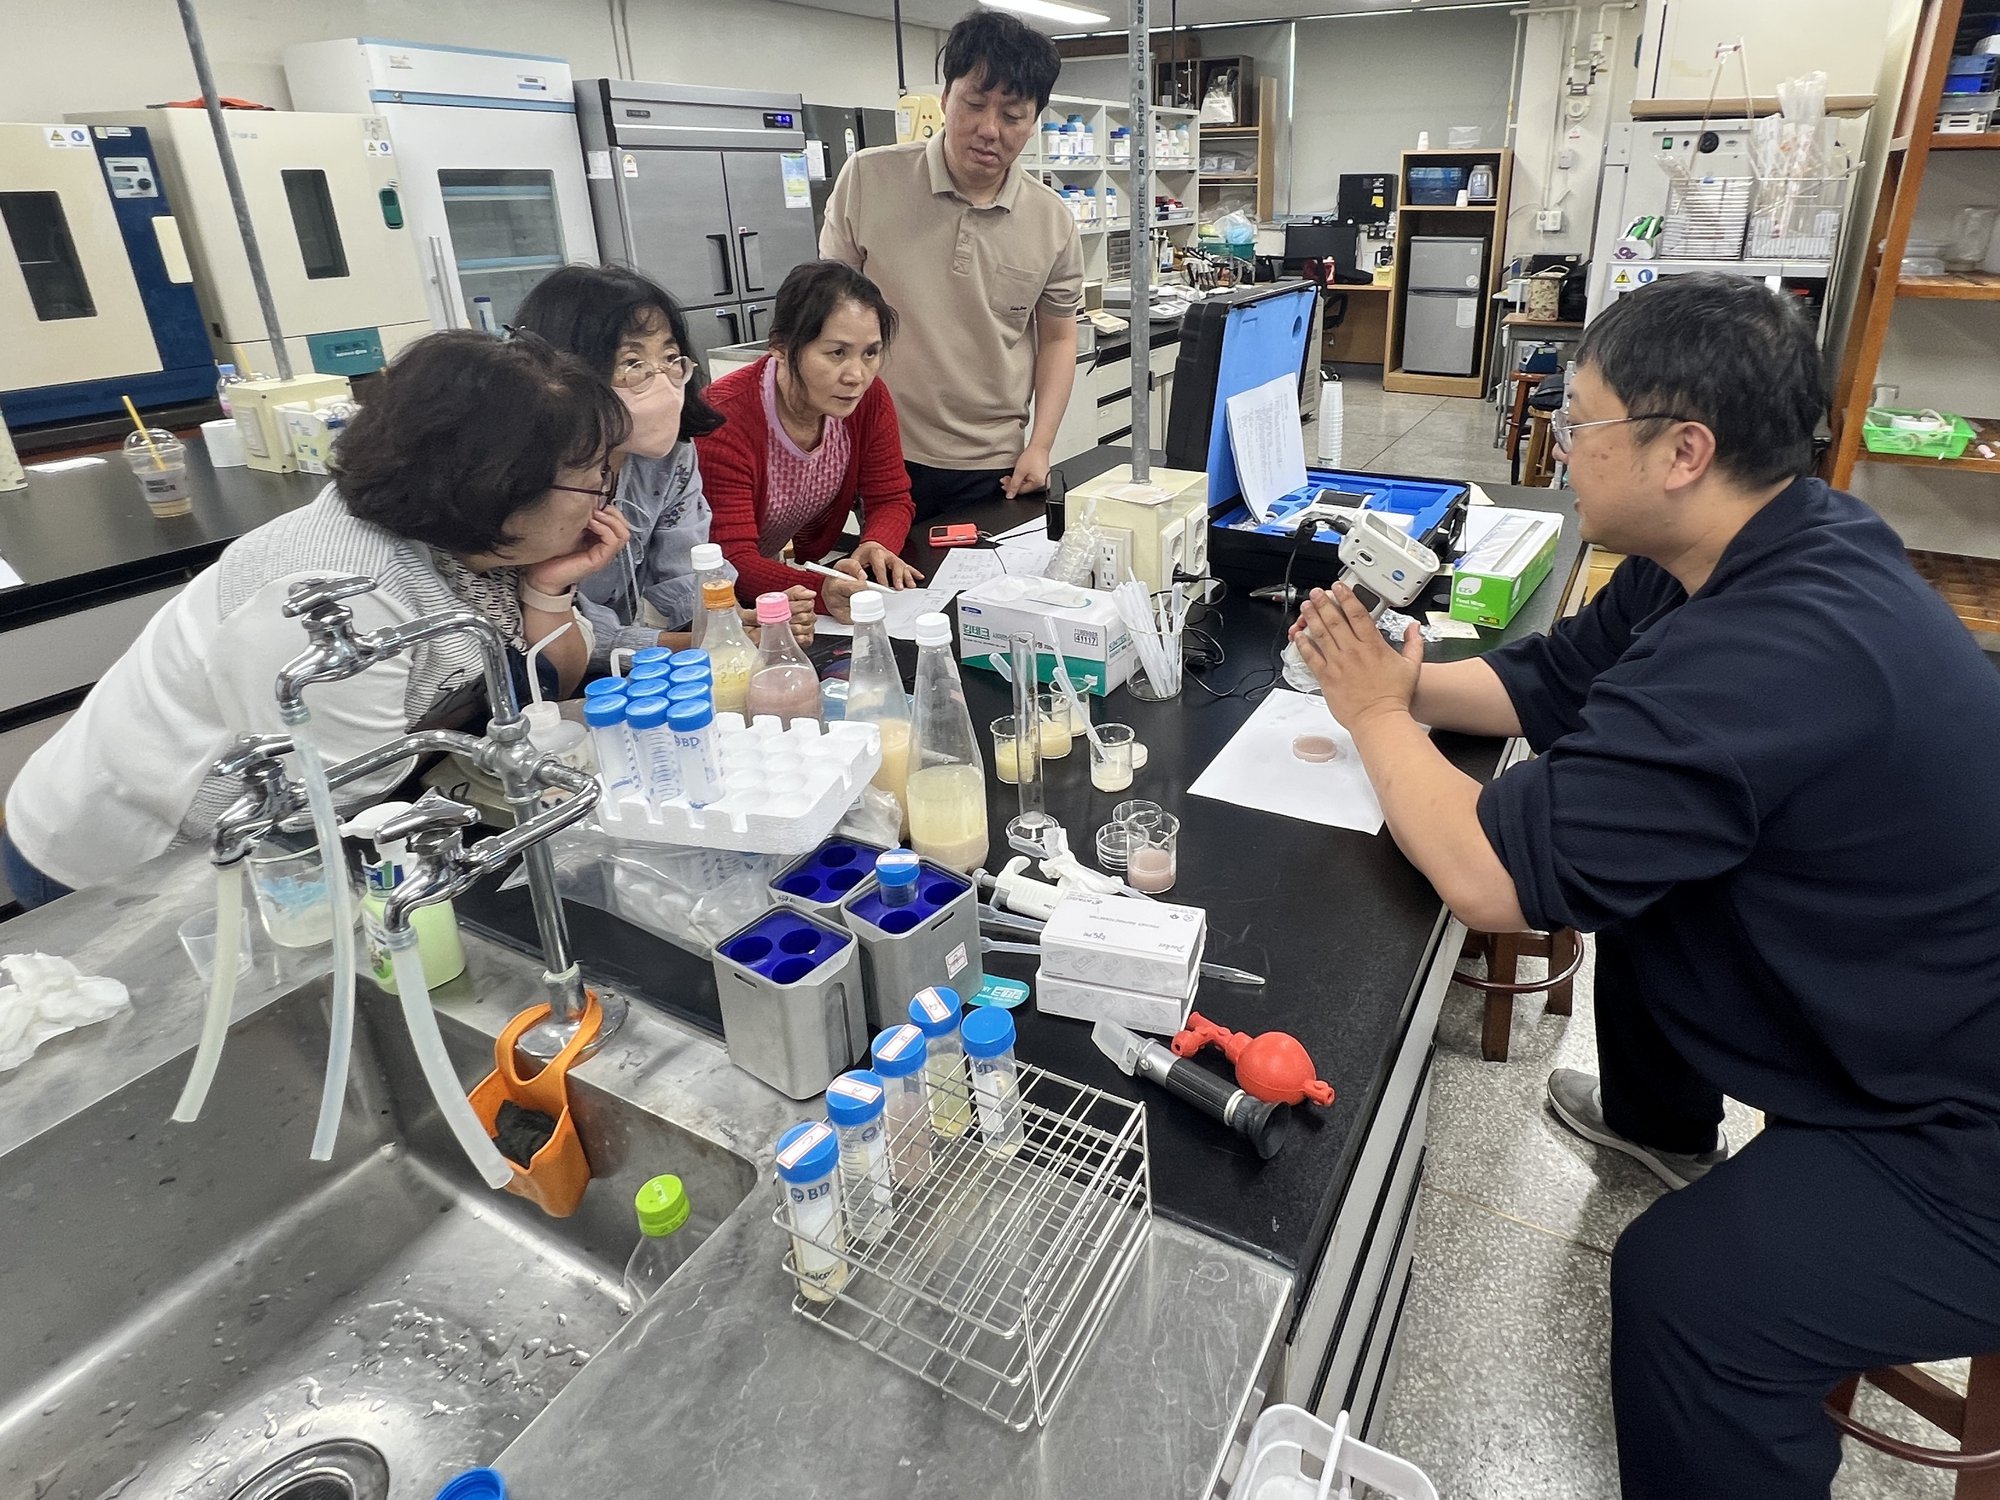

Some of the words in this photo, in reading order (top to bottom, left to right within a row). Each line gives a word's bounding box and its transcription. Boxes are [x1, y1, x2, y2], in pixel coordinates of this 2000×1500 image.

[1138, 184, 1146, 233] HUSTEEL
[681, 737, 700, 749] BD
[808, 1181, 830, 1201] BD
